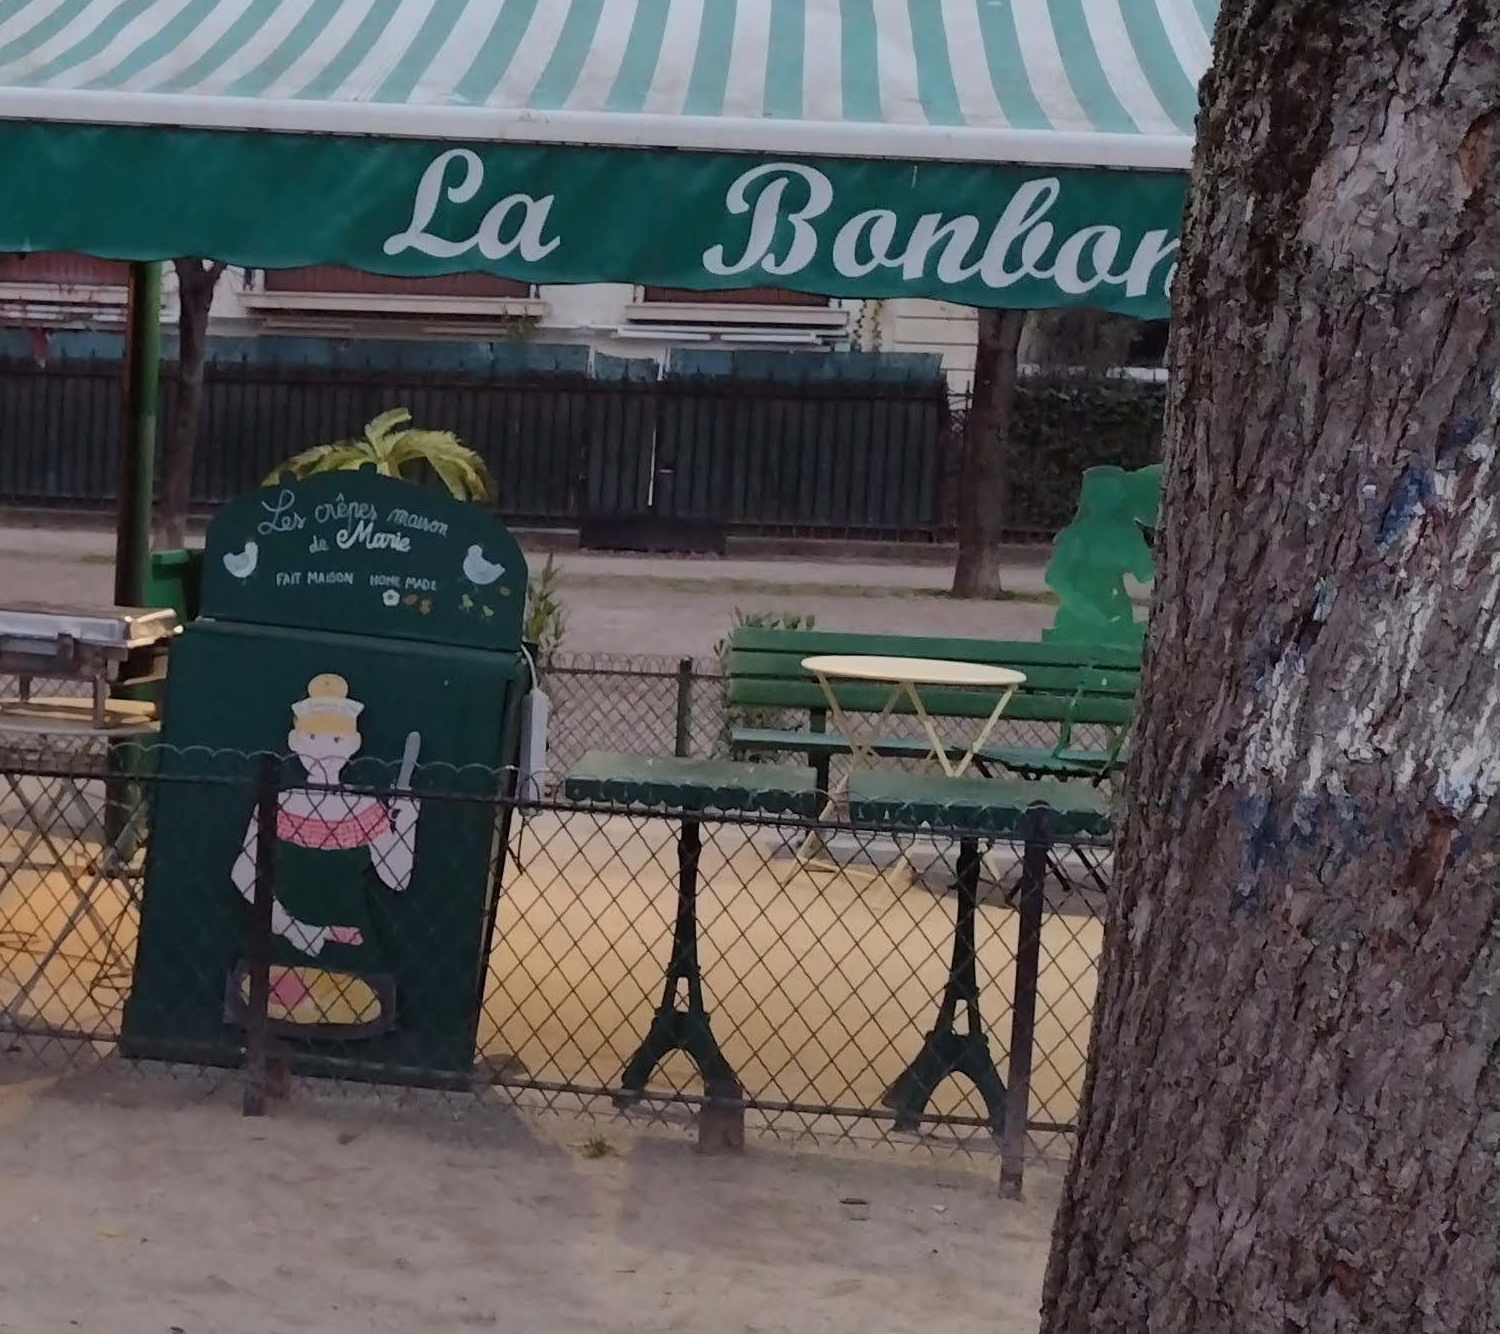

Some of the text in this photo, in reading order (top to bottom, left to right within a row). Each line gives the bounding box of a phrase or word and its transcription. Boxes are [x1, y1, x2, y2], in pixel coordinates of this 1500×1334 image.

[383, 148, 1182, 299] La Bonbon
[257, 489, 449, 538] Les crêpes maison
[309, 520, 412, 553] de Marie
[276, 571, 437, 592] FAIT MAISON HOME MADE
